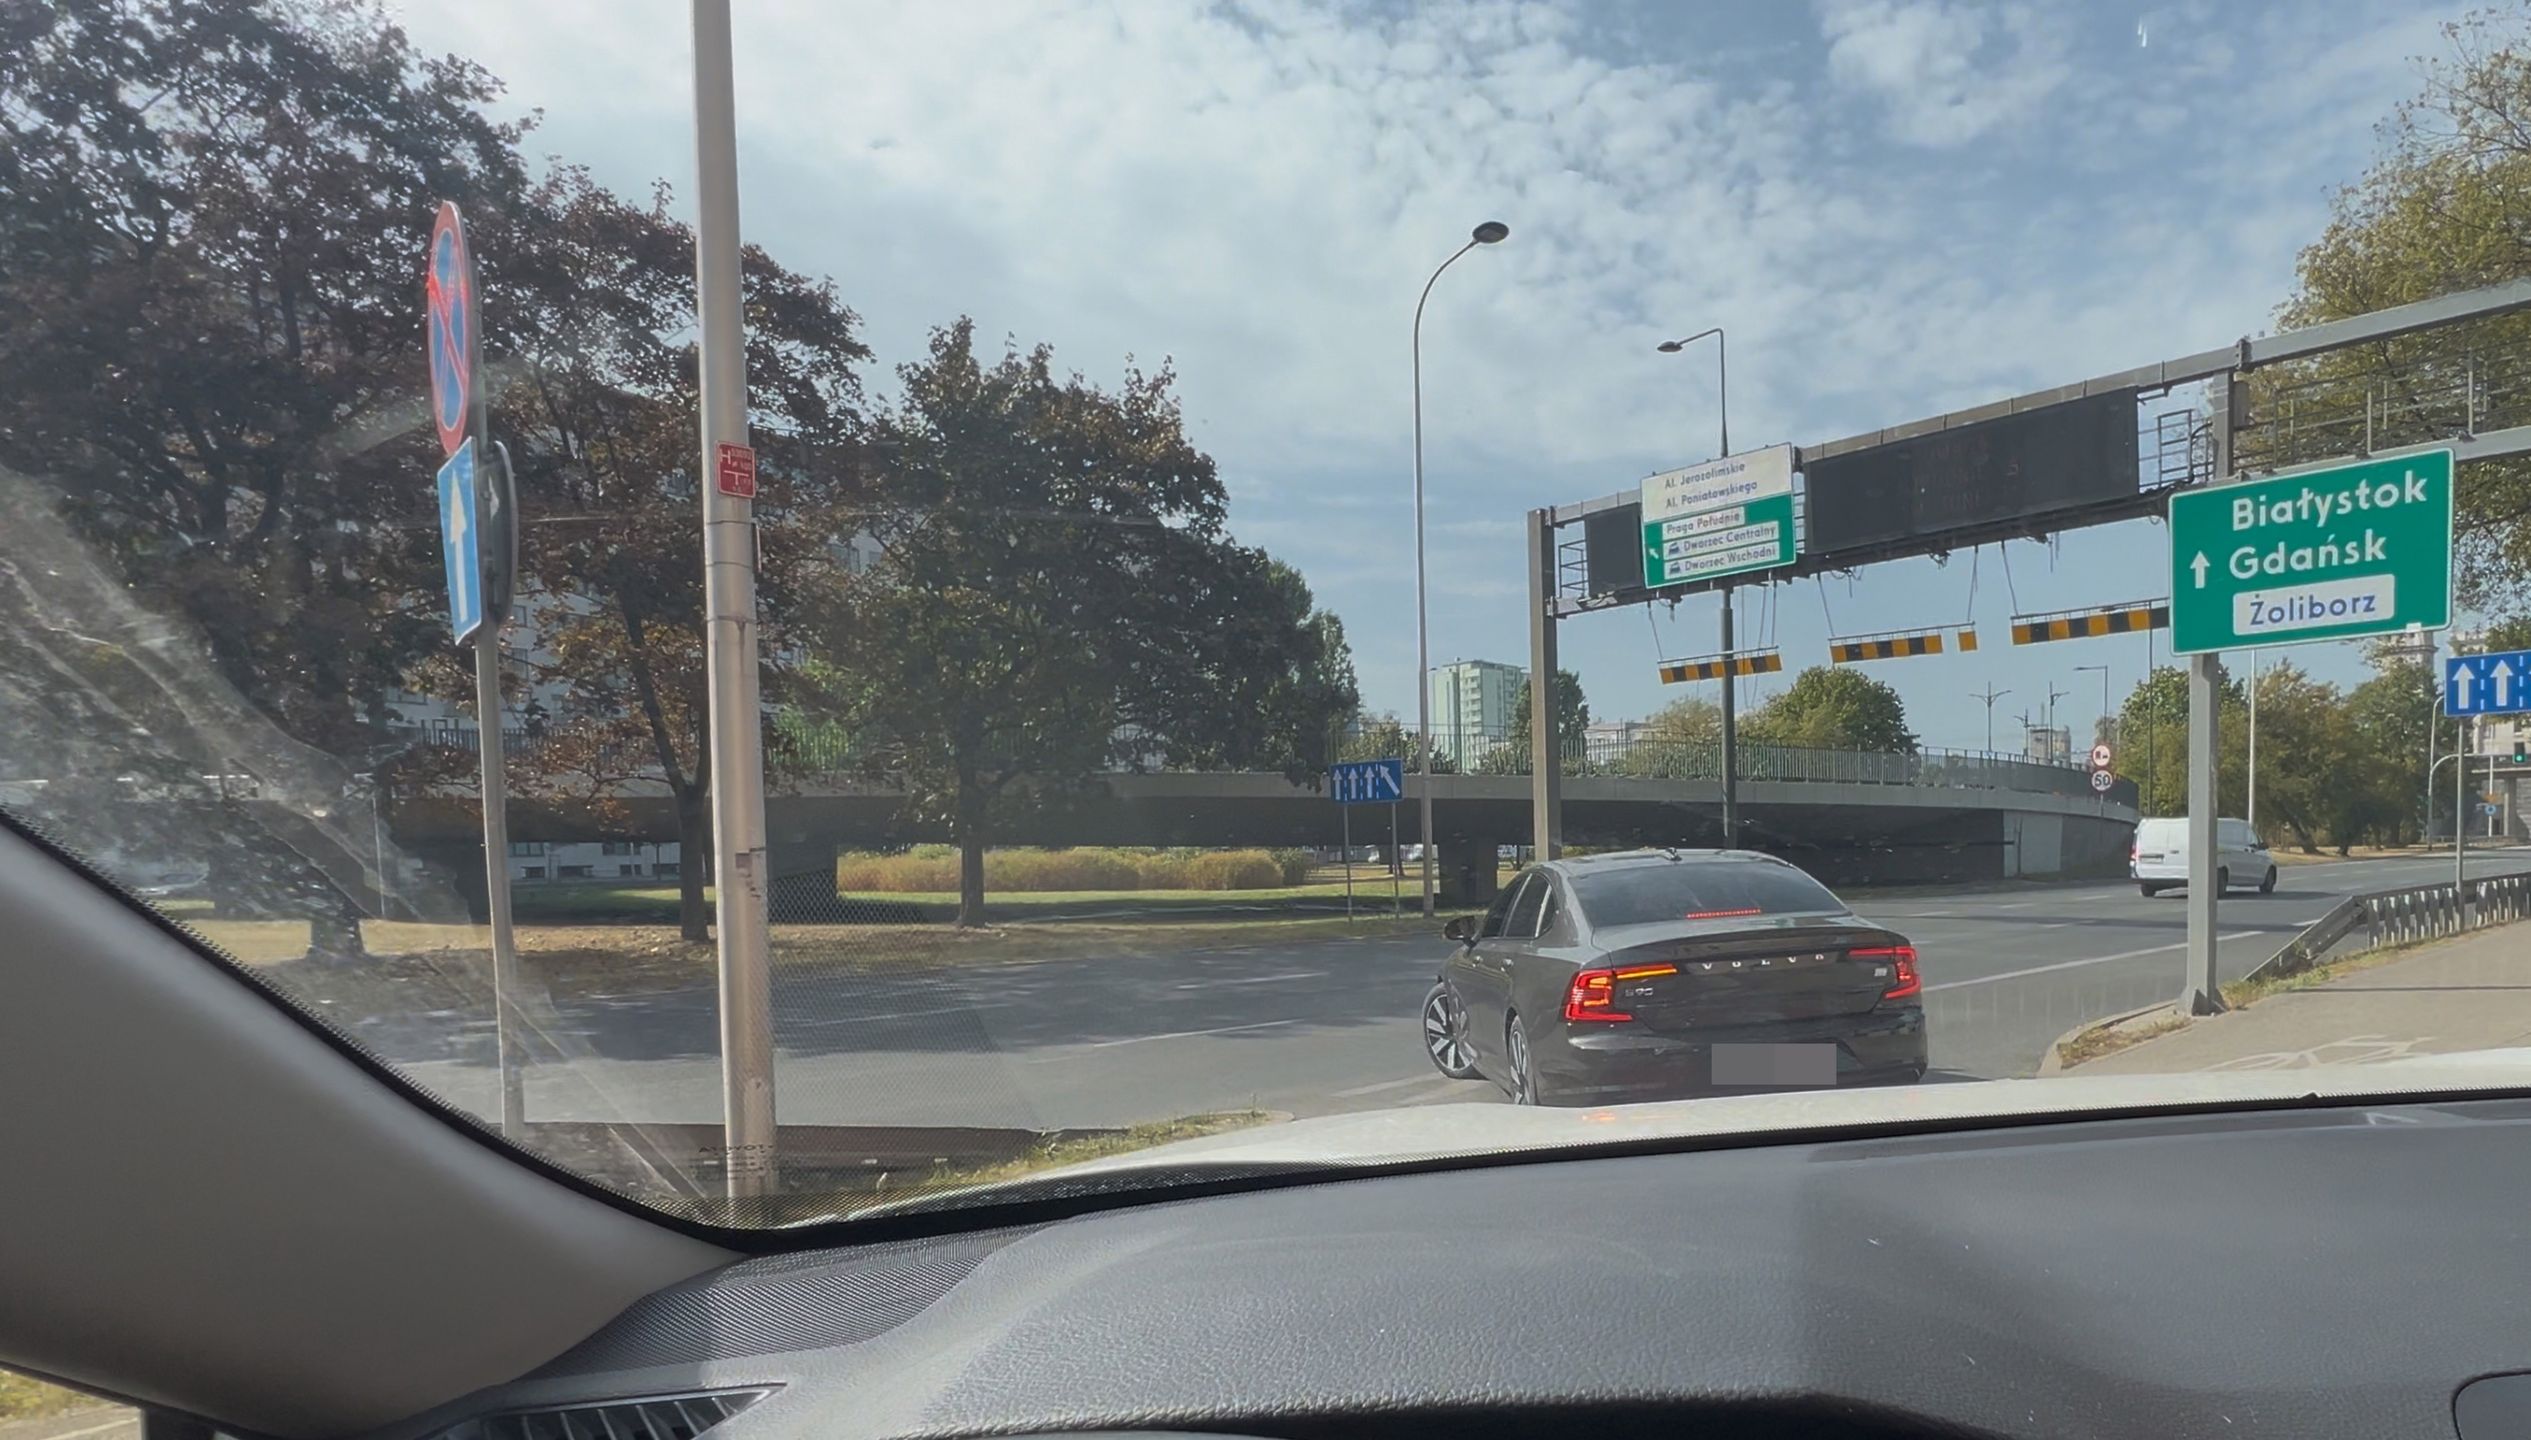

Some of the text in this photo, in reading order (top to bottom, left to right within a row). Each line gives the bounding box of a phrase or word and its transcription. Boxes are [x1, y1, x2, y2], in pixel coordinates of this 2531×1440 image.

[1681, 463, 1745, 485] Jerozolimskie
[1681, 481, 1757, 504] Poniatowskiego
[2231, 470, 2429, 531] Białystok
[1667, 511, 1741, 535] Praga Południe
[1684, 524, 1776, 552] Dworzec Centralny
[1685, 546, 1776, 571] Dworzec Wschodni
[2229, 528, 2387, 580] Gdańsk
[2250, 593, 2377, 626] Żoliborz
[2094, 774, 2111, 786] 50
[1702, 954, 1824, 970] VOLVO
